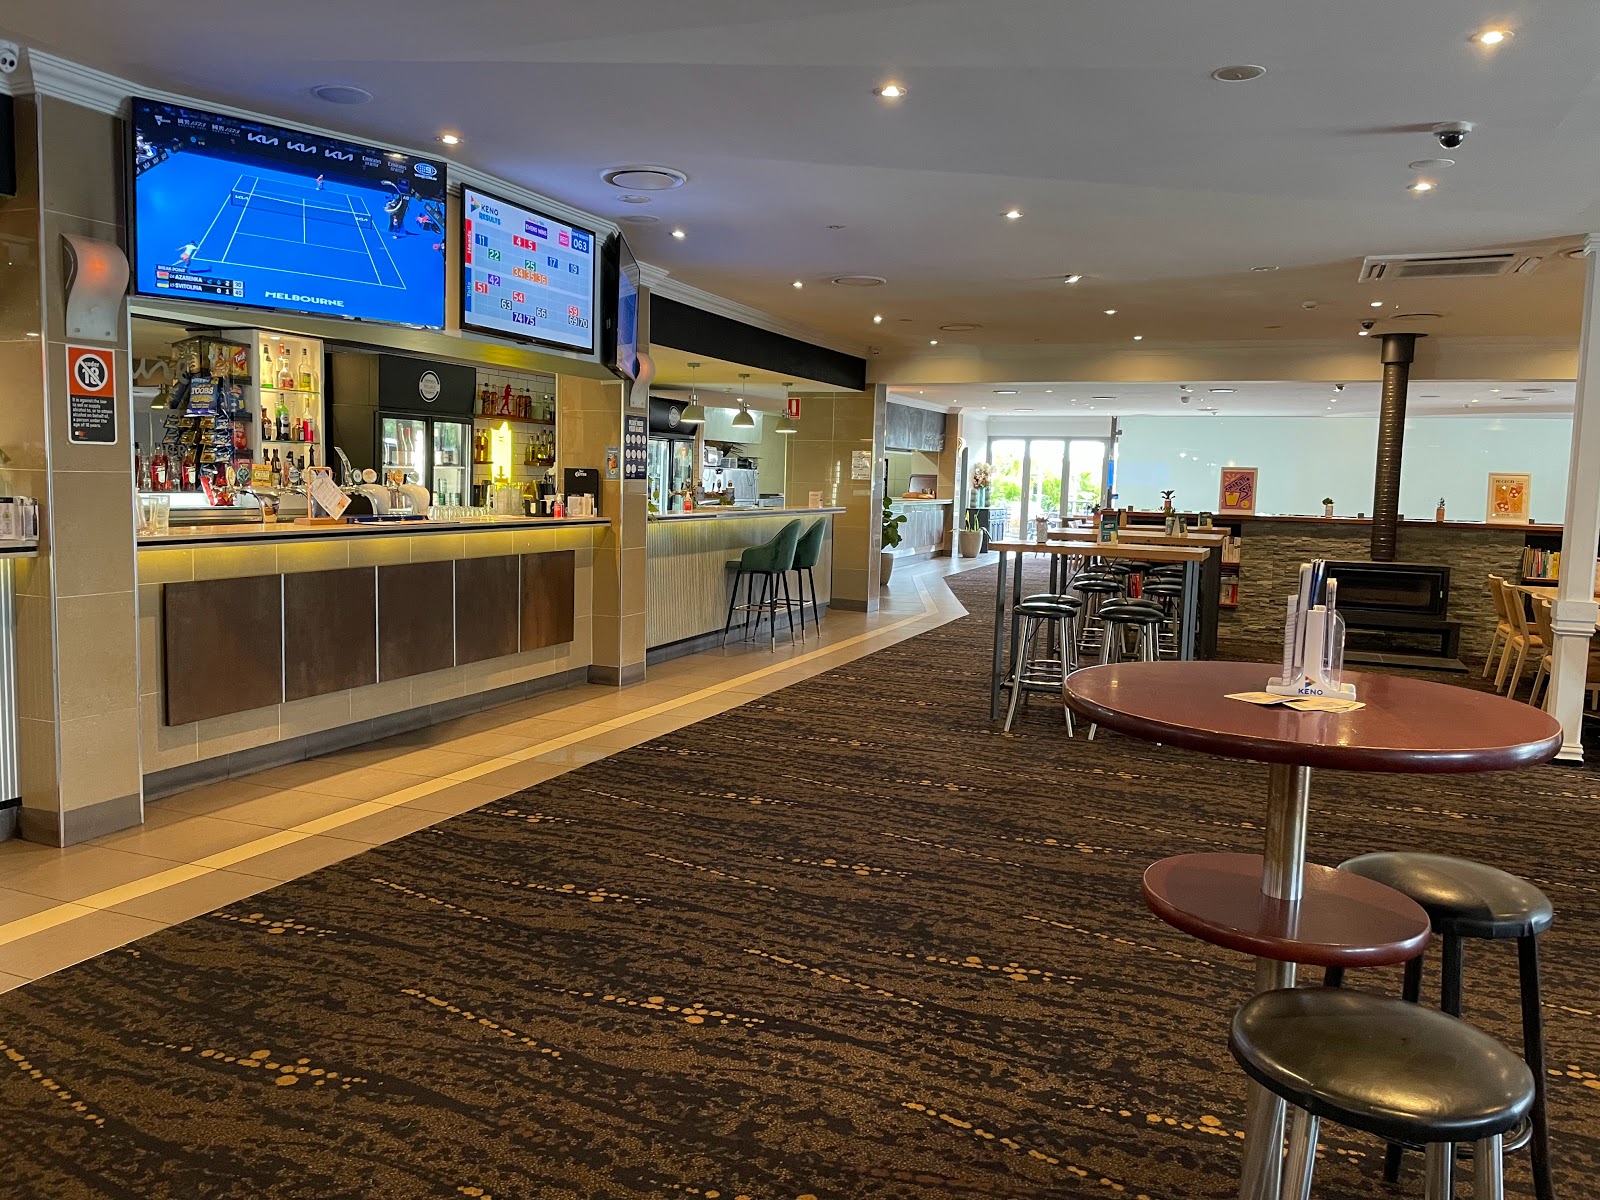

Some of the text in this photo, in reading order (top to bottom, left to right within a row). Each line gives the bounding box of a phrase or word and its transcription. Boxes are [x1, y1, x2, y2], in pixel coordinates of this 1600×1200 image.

[481, 204, 498, 216] KENO
[479, 212, 500, 225] RESULTS
[516, 238, 533, 249] 4 5
[574, 239, 586, 251] 063
[478, 235, 577, 274] 11 17 19
[489, 250, 535, 270] 22 25
[489, 275, 499, 286] 42
[514, 268, 546, 283] 34 35 36
[175, 283, 202, 291] SVITOLINA
[265, 291, 344, 307] MELBOURNE
[477, 283, 578, 316] 51 54 59
[502, 300, 587, 328] 63 66 69 70
[514, 312, 535, 326] 74 75
[82, 368, 99, 384] 18
